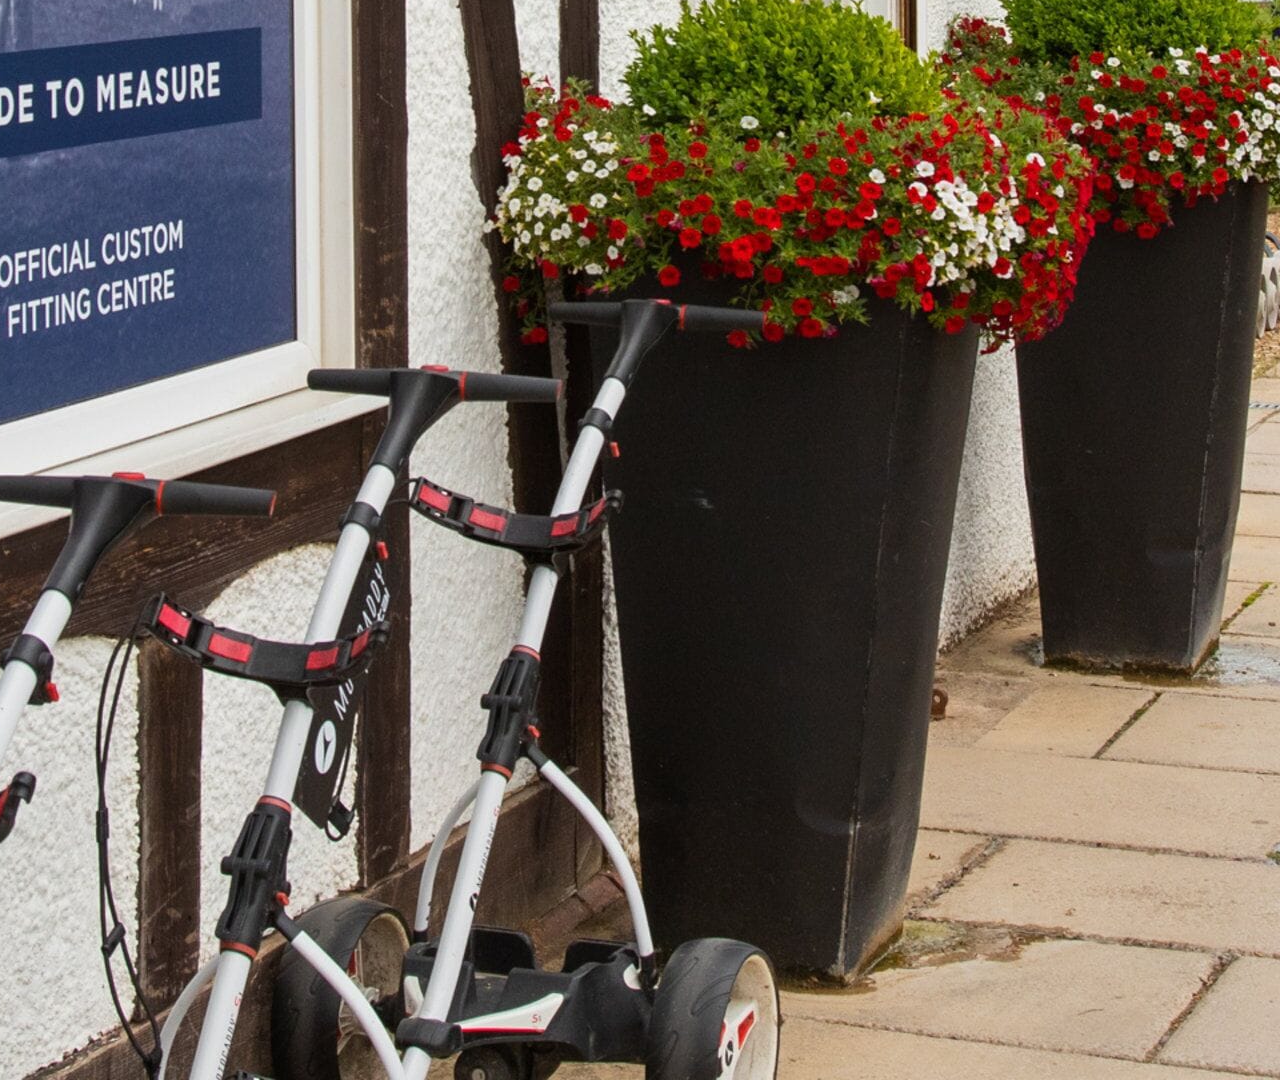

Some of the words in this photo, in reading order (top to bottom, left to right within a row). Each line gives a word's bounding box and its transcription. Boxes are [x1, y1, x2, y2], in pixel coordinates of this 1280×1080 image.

[46, 77, 85, 119] TO
[96, 61, 221, 112] MEASURE
[101, 219, 184, 266] CUSTOM
[7, 288, 91, 338] FITTING
[97, 269, 176, 316] CENTRE
